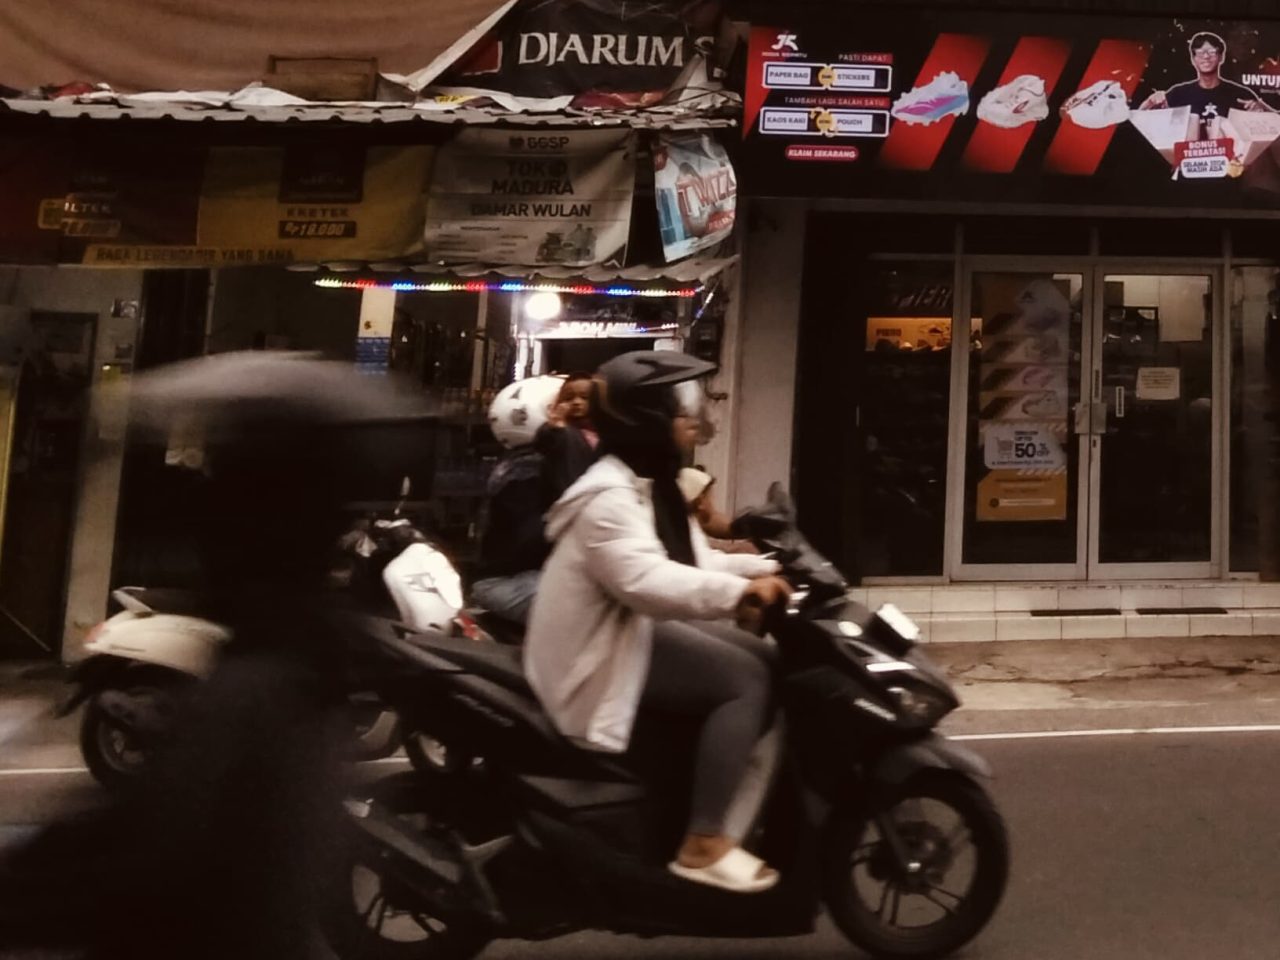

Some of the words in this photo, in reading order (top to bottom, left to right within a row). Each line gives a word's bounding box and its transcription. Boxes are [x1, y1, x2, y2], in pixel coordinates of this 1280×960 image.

[518, 31, 684, 67] DJARUM
[1188, 140, 1218, 149] BONUS
[491, 179, 575, 195] MADURA
[470, 203, 529, 217] DAMAR
[532, 203, 592, 217] WULAN
[1015, 442, 1037, 458] 50
